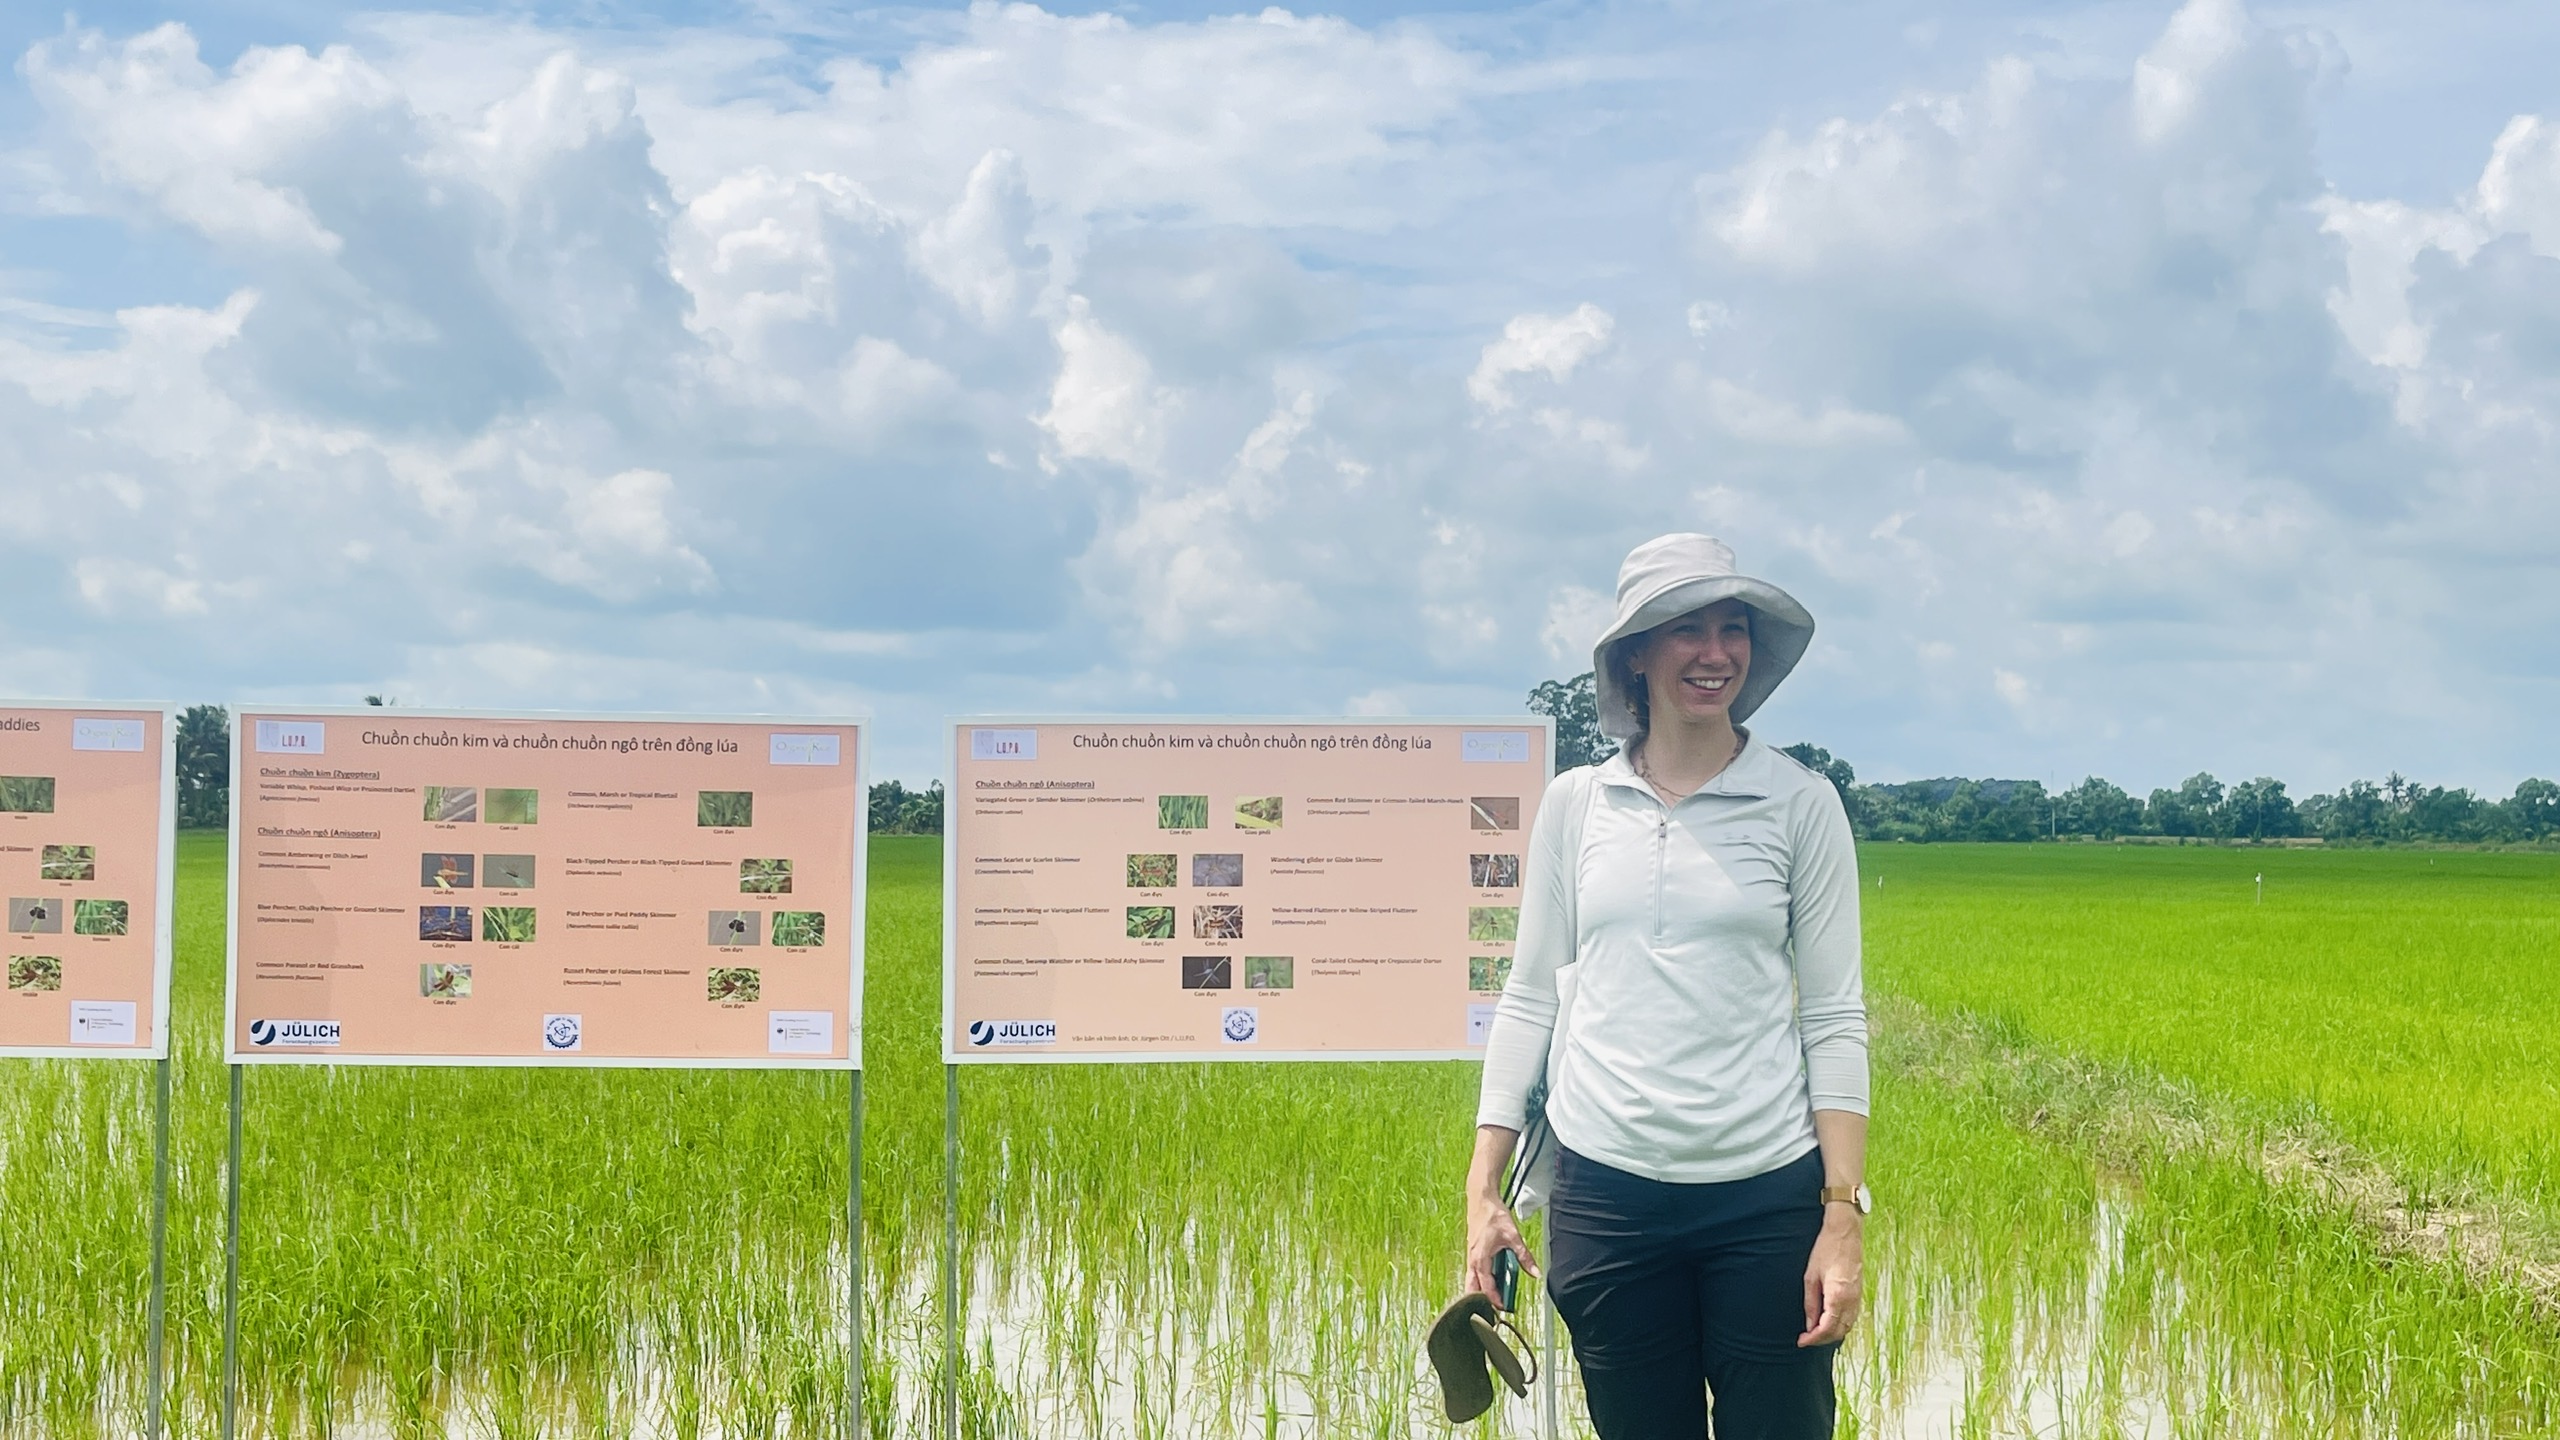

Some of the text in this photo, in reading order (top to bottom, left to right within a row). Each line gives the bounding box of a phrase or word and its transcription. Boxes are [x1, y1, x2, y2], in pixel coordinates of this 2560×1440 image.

[362, 730, 738, 754] Chuồn chuồn kim và chuồn chuồn ngô trên đồng lúa
[1073, 732, 1432, 753] Chuồn chuồn kim và chuồn chuồn ngô trên đồng lúa
[317, 769, 331, 777] kim
[333, 770, 380, 779] (Zygoptera)
[976, 780, 1001, 788] Chuồn
[1004, 781, 1027, 789] chuồn
[1047, 781, 1095, 789] (Anisoptera)
[331, 829, 381, 839] (Anisoptera)
[282, 1022, 340, 1037] JÜLICH
[1000, 1022, 1056, 1036] JÜLICH
